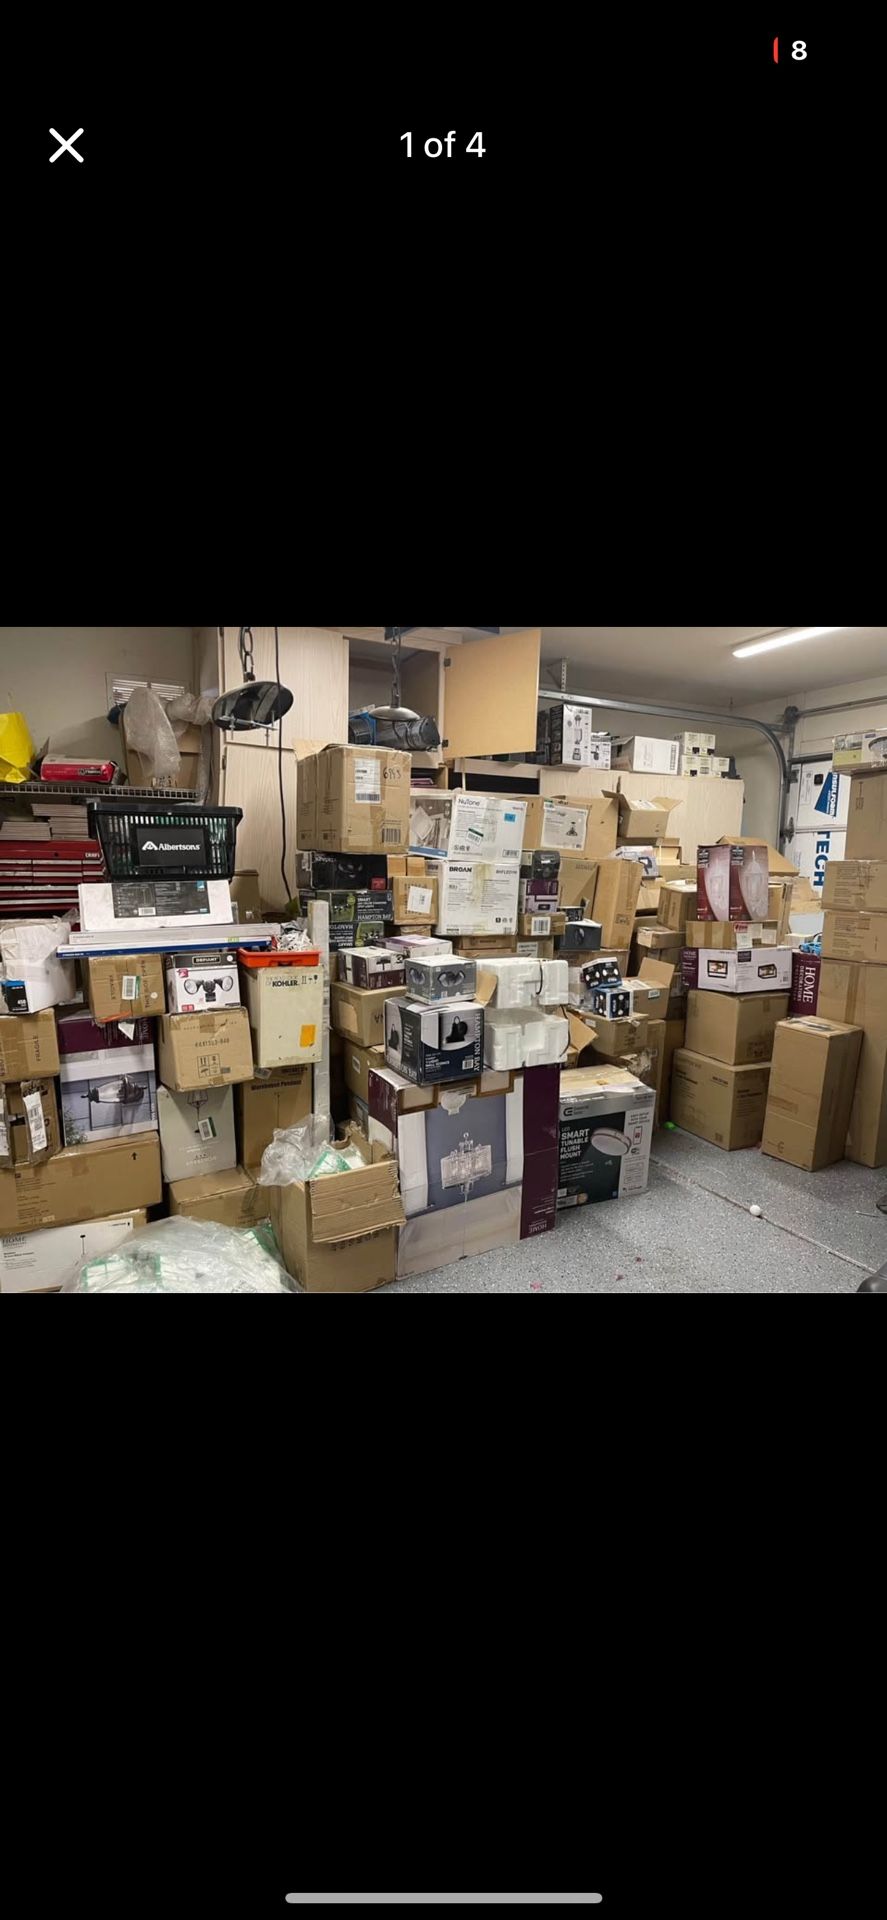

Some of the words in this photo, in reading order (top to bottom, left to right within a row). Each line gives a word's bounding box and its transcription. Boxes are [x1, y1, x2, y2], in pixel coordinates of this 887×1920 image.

[158, 843, 201, 851] Albertsons
[802, 966, 816, 1004] HOME
[473, 1013, 482, 1055] HAMPTON
[561, 1128, 590, 1141] SMART
[561, 1137, 589, 1147] TUNABLE
[560, 1145, 581, 1154] FLUSH
[560, 1150, 582, 1160] MOUNT
